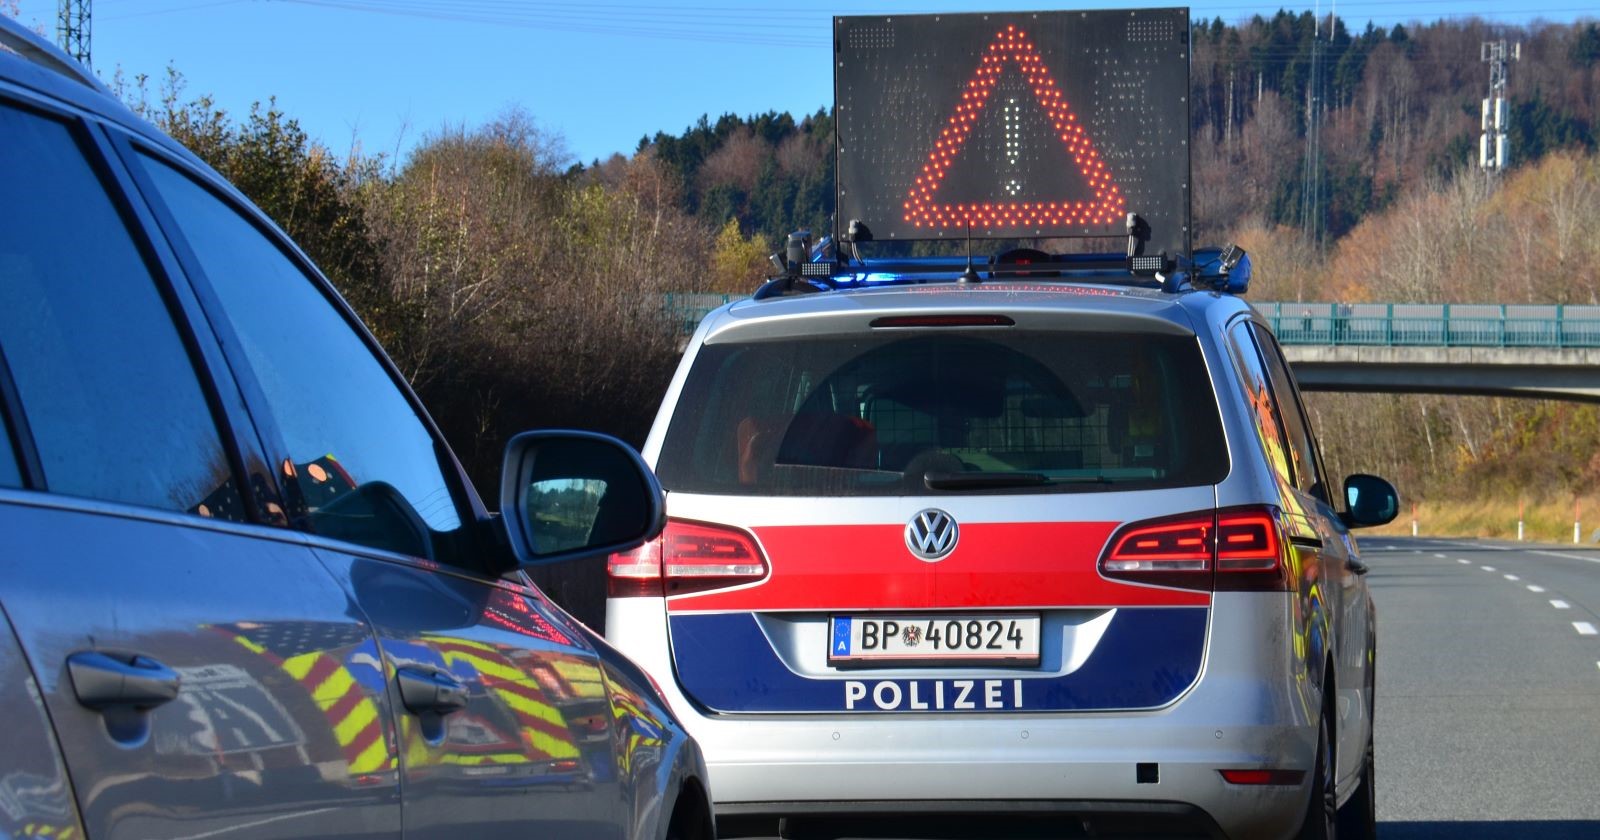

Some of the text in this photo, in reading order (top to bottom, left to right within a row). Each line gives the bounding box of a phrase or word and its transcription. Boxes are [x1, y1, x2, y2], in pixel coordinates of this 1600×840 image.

[837, 641, 847, 651] A
[861, 620, 1023, 650] BP 40824
[845, 679, 1023, 710] POLIZEI
